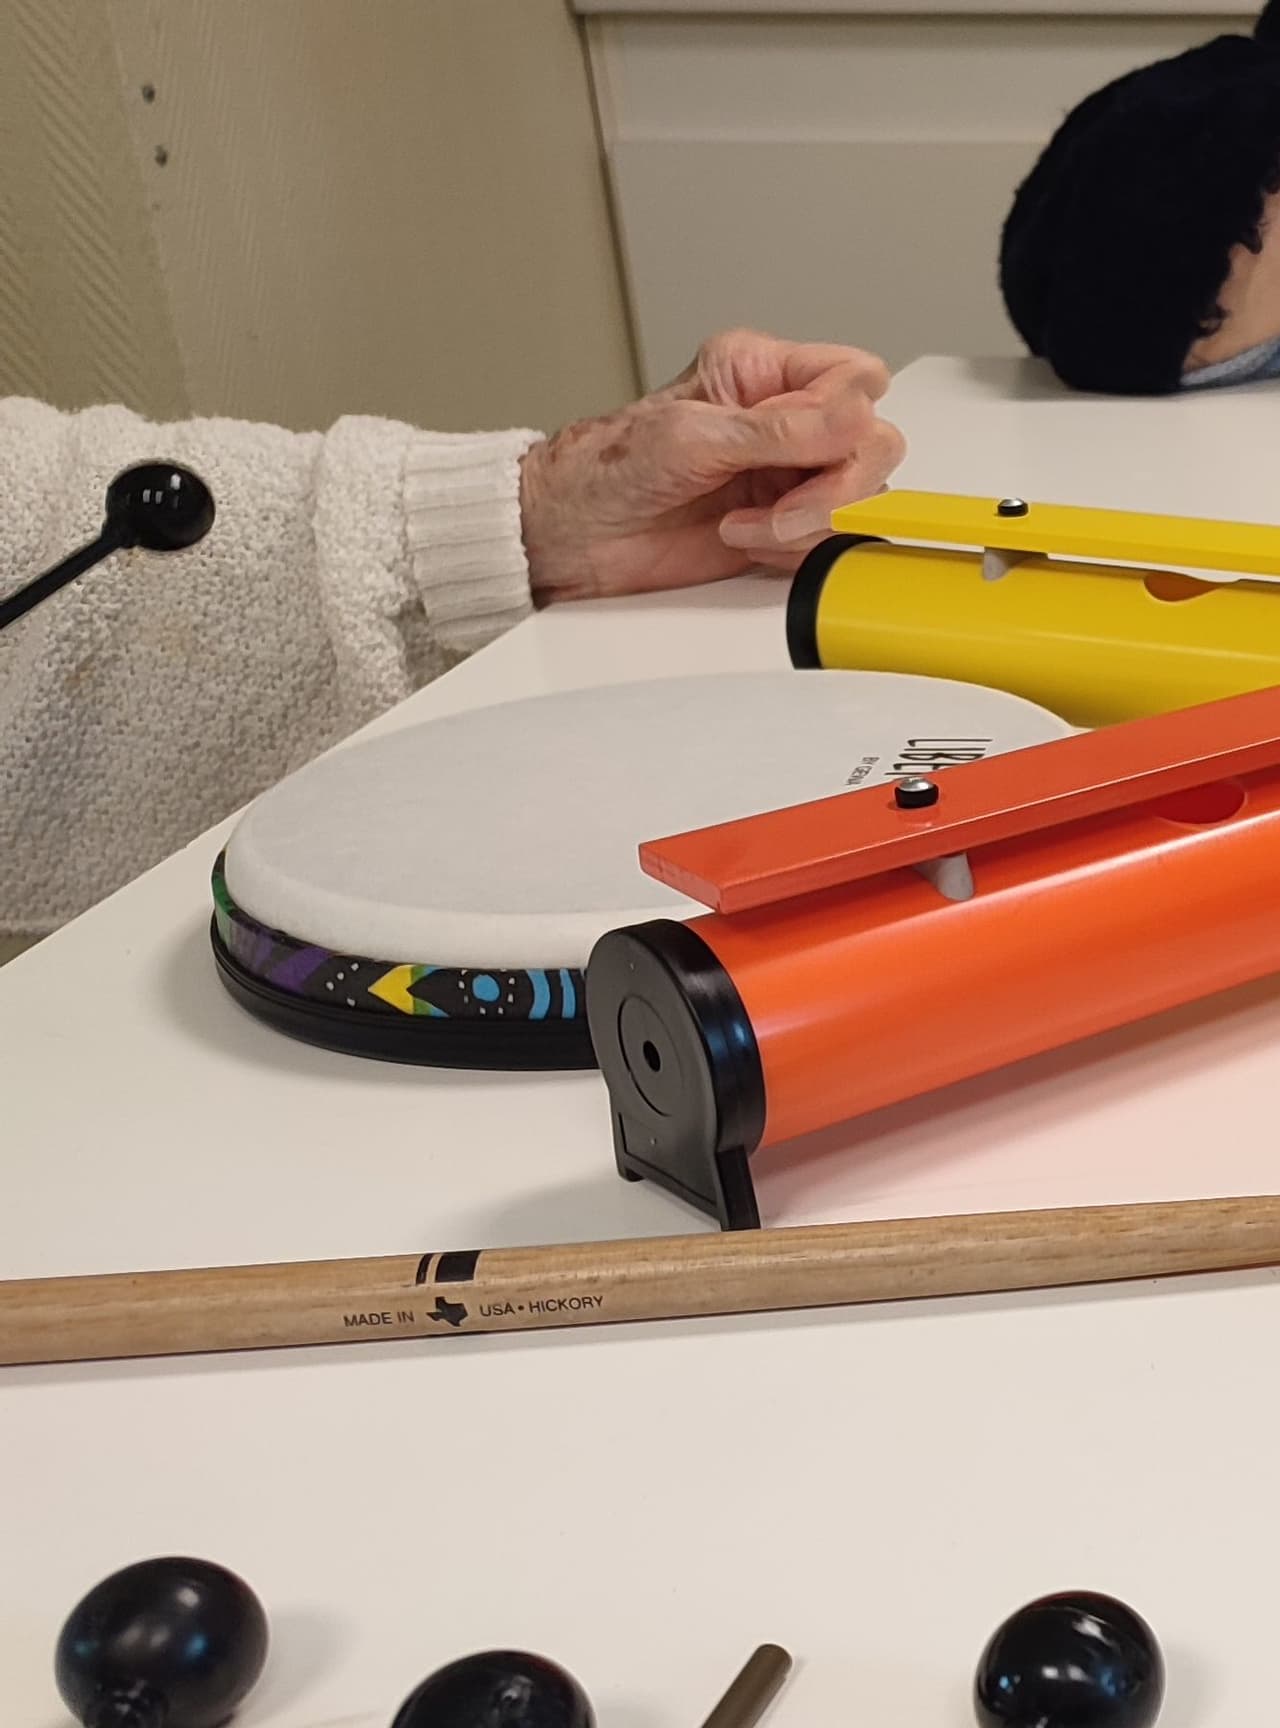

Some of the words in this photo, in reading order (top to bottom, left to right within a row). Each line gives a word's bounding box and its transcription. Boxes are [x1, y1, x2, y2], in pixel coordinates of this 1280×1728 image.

[343, 1311, 392, 1328] MADE
[398, 1310, 415, 1324] IN
[479, 1304, 515, 1318] USA
[528, 1295, 605, 1314] HICKORY
